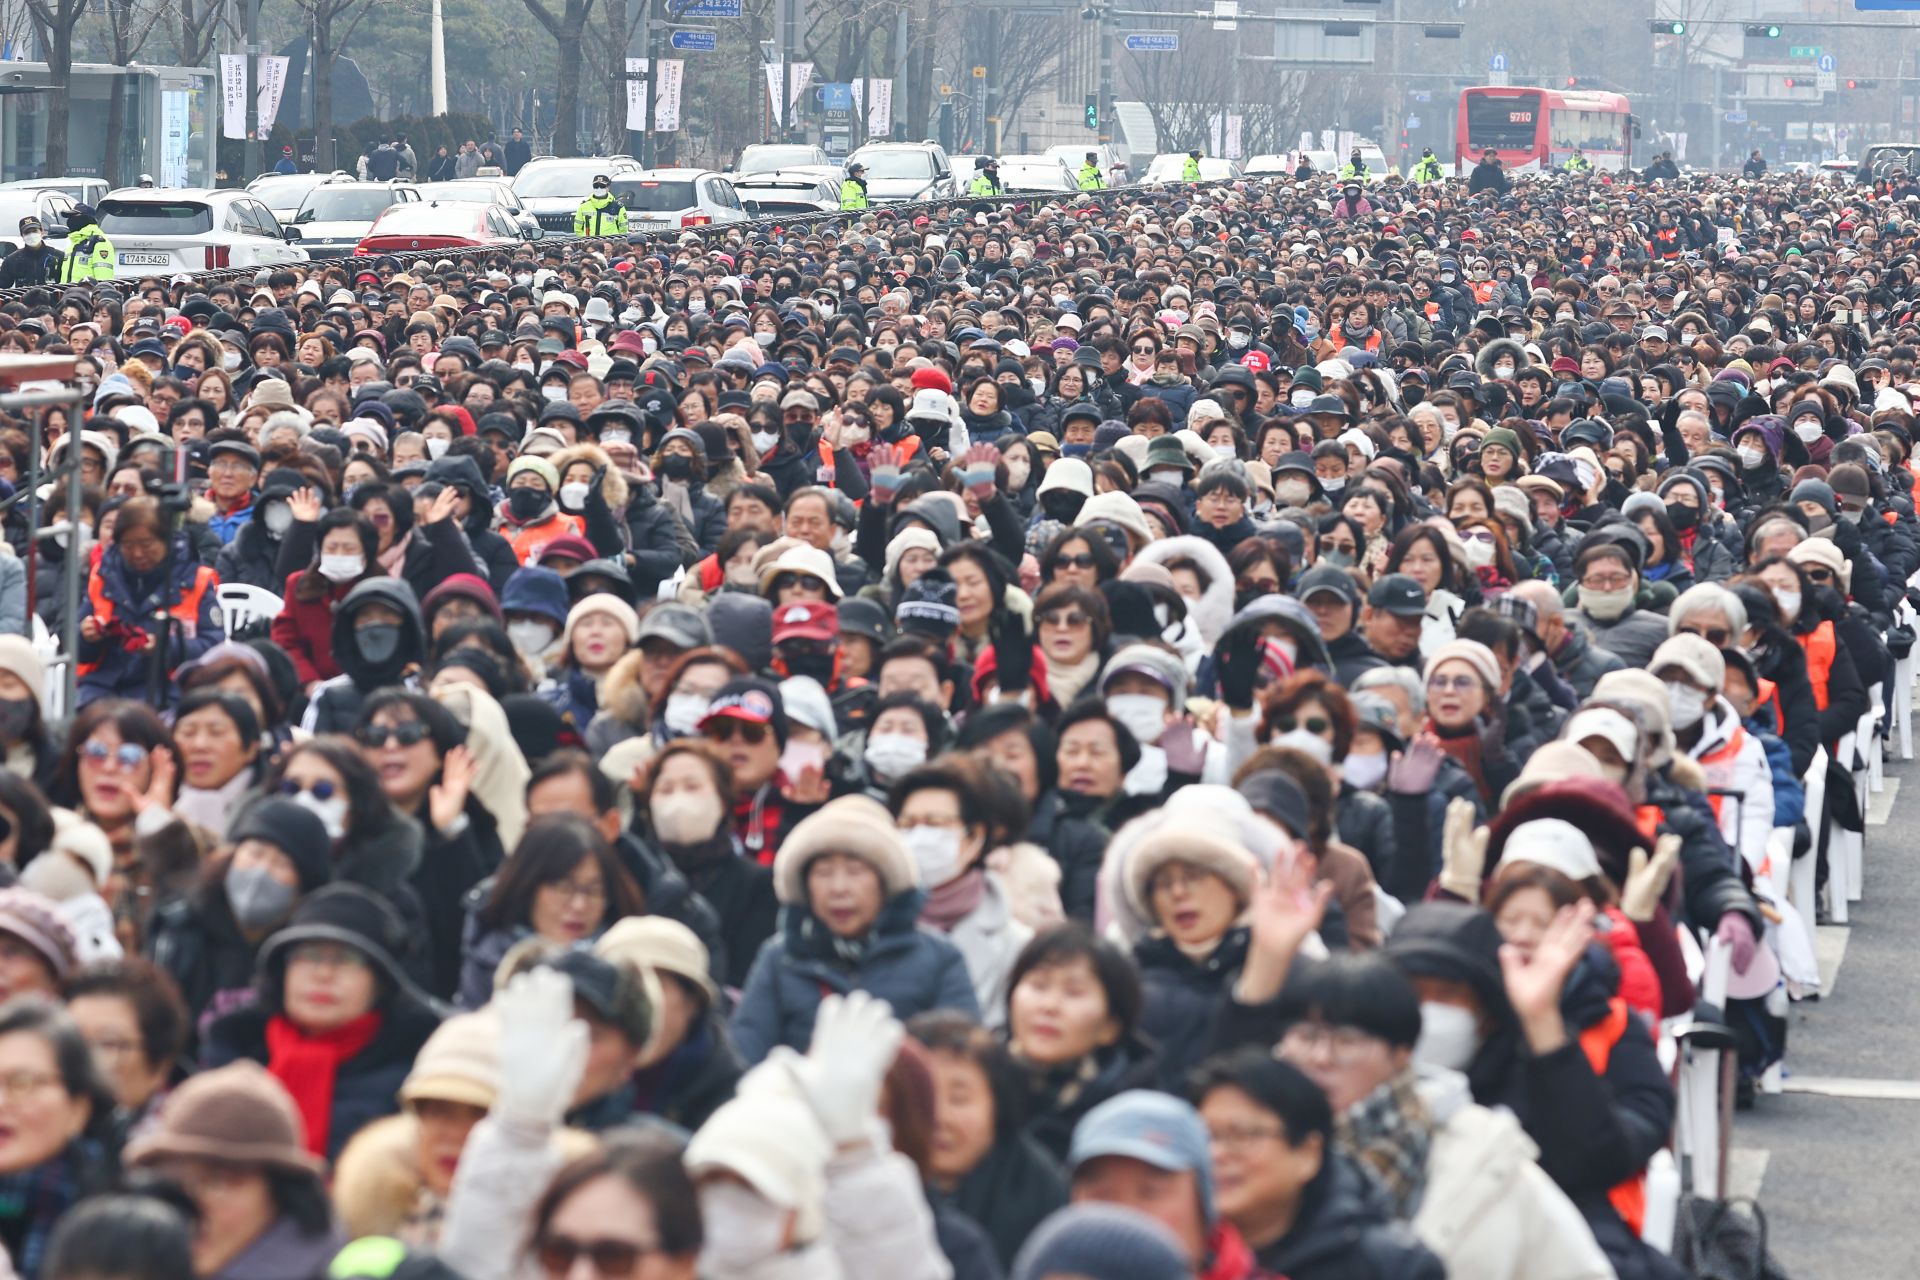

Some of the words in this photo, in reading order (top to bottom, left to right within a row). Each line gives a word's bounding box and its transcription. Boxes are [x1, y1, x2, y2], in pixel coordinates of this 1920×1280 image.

[827, 110, 846, 118] 6701
[1509, 112, 1532, 122] 9710
[148, 255, 167, 264] 5426
